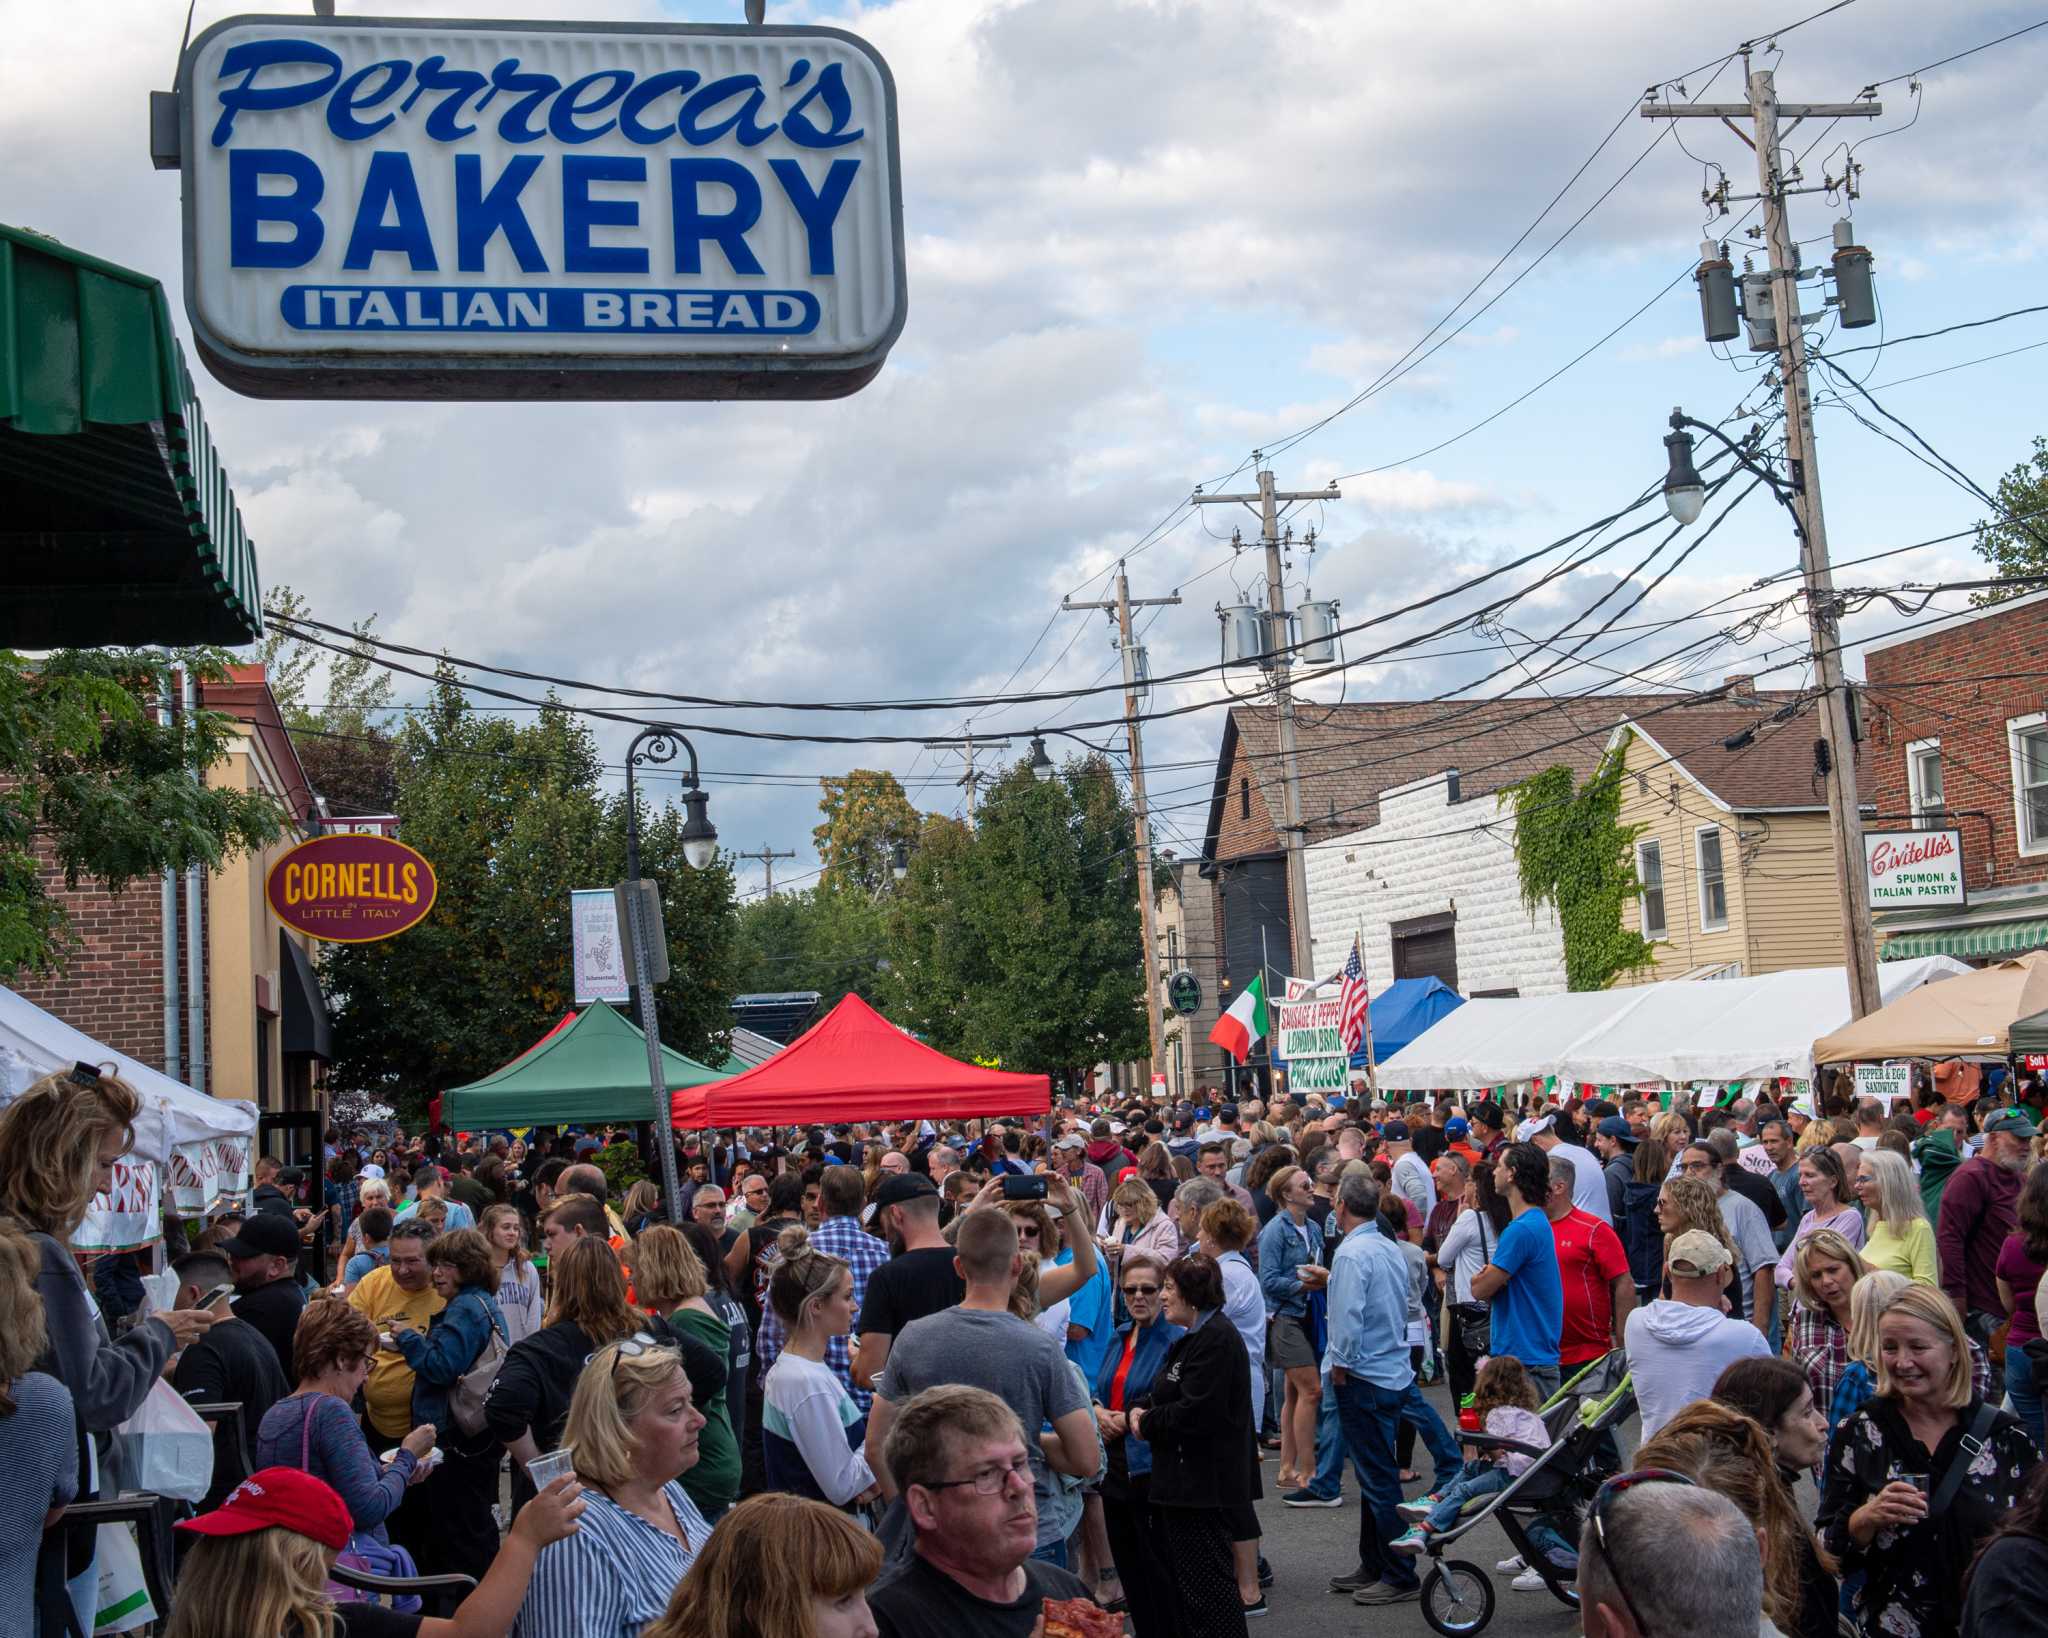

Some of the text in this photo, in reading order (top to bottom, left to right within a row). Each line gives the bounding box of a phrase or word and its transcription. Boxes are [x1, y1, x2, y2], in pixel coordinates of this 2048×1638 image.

[211, 38, 864, 149] Perreca's
[228, 148, 862, 276] BAKERY
[303, 288, 808, 330] ITALIAN BREAD
[1871, 834, 1954, 876] Civitello's
[285, 862, 418, 905] CORNELLS
[1873, 884, 1957, 898] ITALIAN PASTRY
[1896, 871, 1958, 884] SPUMONI &
[302, 908, 401, 919] LITTLE ITALY
[1281, 1001, 1341, 1030] SAUSAGE & PEPPE
[1286, 1028, 1342, 1054] LONDON BROIL
[1857, 1068, 1906, 1080] PEPPER & EGG
[1865, 1082, 1899, 1093] SANDWICH
